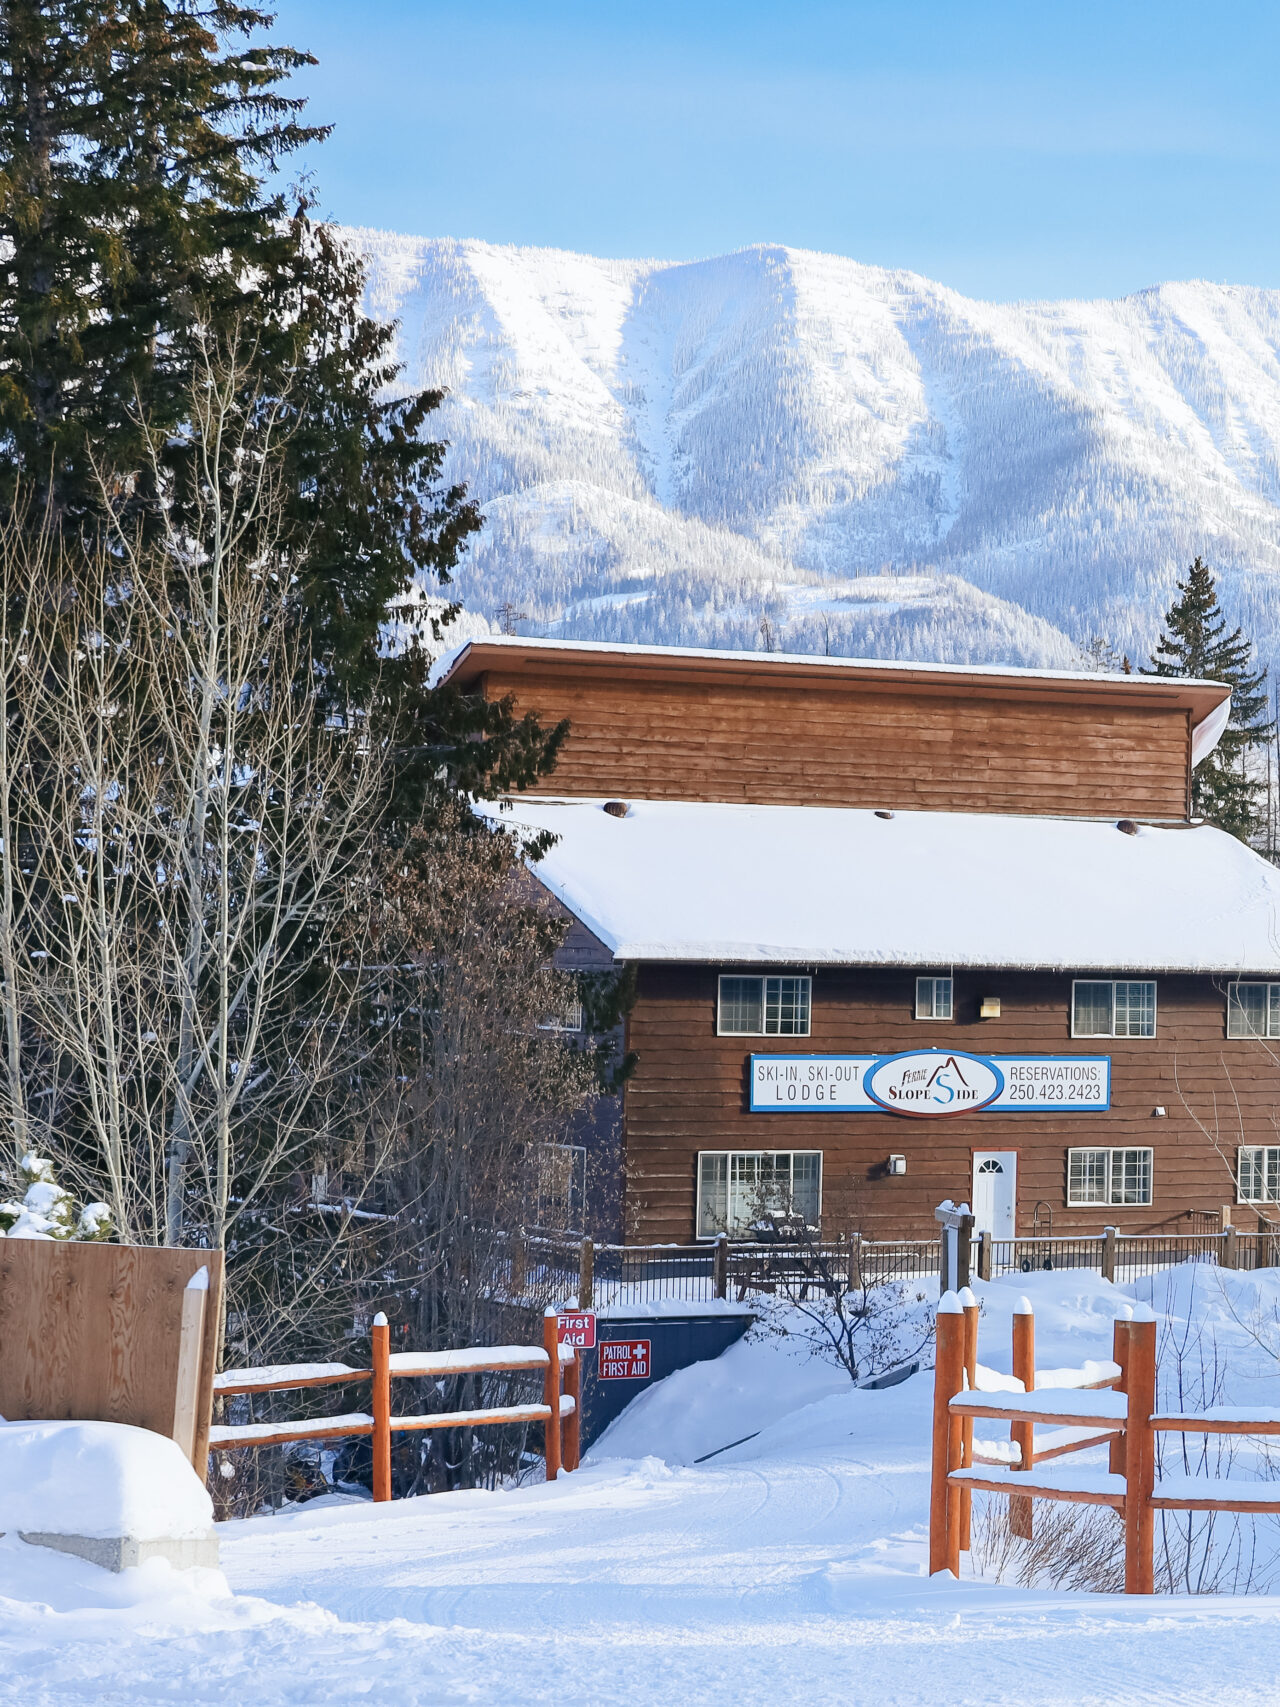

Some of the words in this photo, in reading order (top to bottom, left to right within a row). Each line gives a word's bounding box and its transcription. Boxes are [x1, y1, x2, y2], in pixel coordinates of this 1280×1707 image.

[758, 1065, 802, 1082] SKI-IN,
[808, 1065, 860, 1082] SKI-OUT
[1010, 1066, 1101, 1081] RESERVATIONS:
[776, 1084, 837, 1101] LODGE
[1009, 1084, 1101, 1100] 250.423.2423
[557, 1316, 590, 1329] First
[562, 1332, 585, 1346] Aid
[603, 1345, 632, 1360] PATROL
[602, 1361, 629, 1377] FIRST
[631, 1360, 647, 1376] AID
